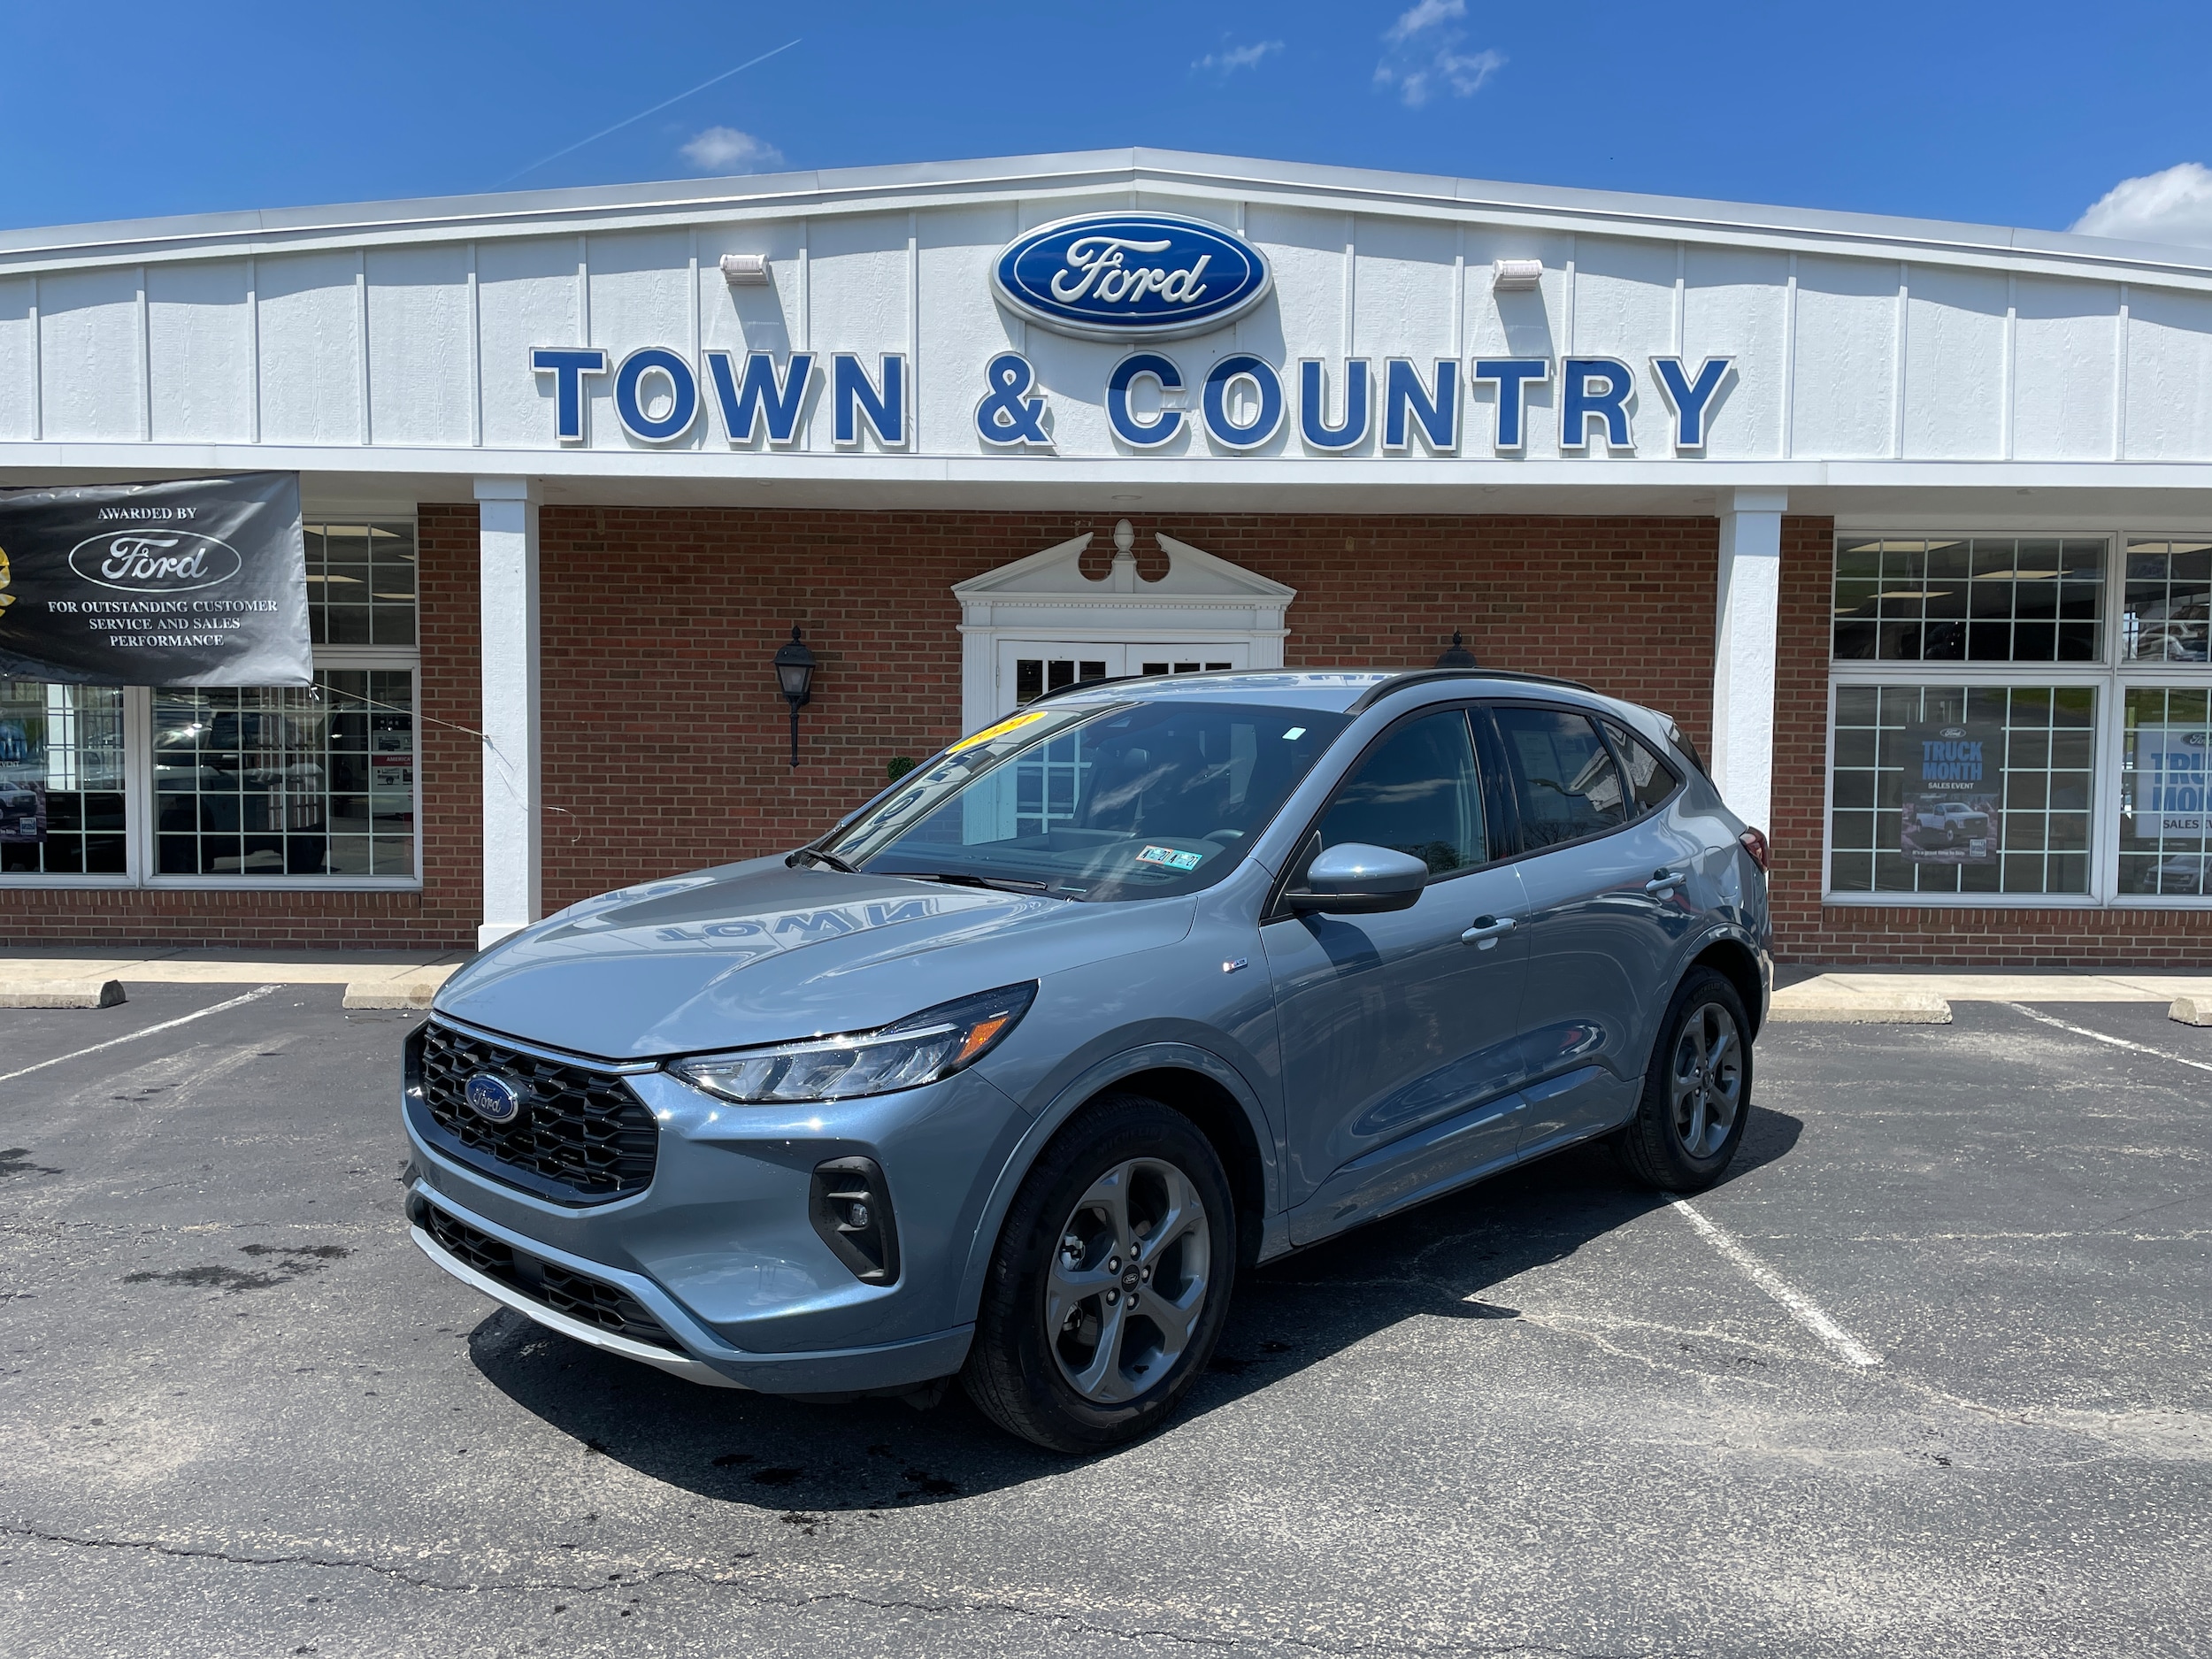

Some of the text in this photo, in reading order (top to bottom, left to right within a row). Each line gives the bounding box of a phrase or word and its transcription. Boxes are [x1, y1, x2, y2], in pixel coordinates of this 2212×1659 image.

[1051, 236, 1212, 303] Ford
[529, 346, 1737, 450] TOWN & COUNTRY
[97, 507, 197, 519] AWARDED BY
[102, 537, 209, 580] Ford
[48, 600, 278, 613] FOR OUTSTANDING CUSTOMER
[89, 617, 241, 630] SERVICE AND SALES
[110, 634, 225, 647] PERFORMANCE
[1922, 741, 1983, 761] TRUCK
[1922, 762, 1983, 780] MONTH
[2151, 753, 2212, 785] TRU
[2162, 819, 2199, 829] SALES
[473, 1082, 503, 1113] Ford
